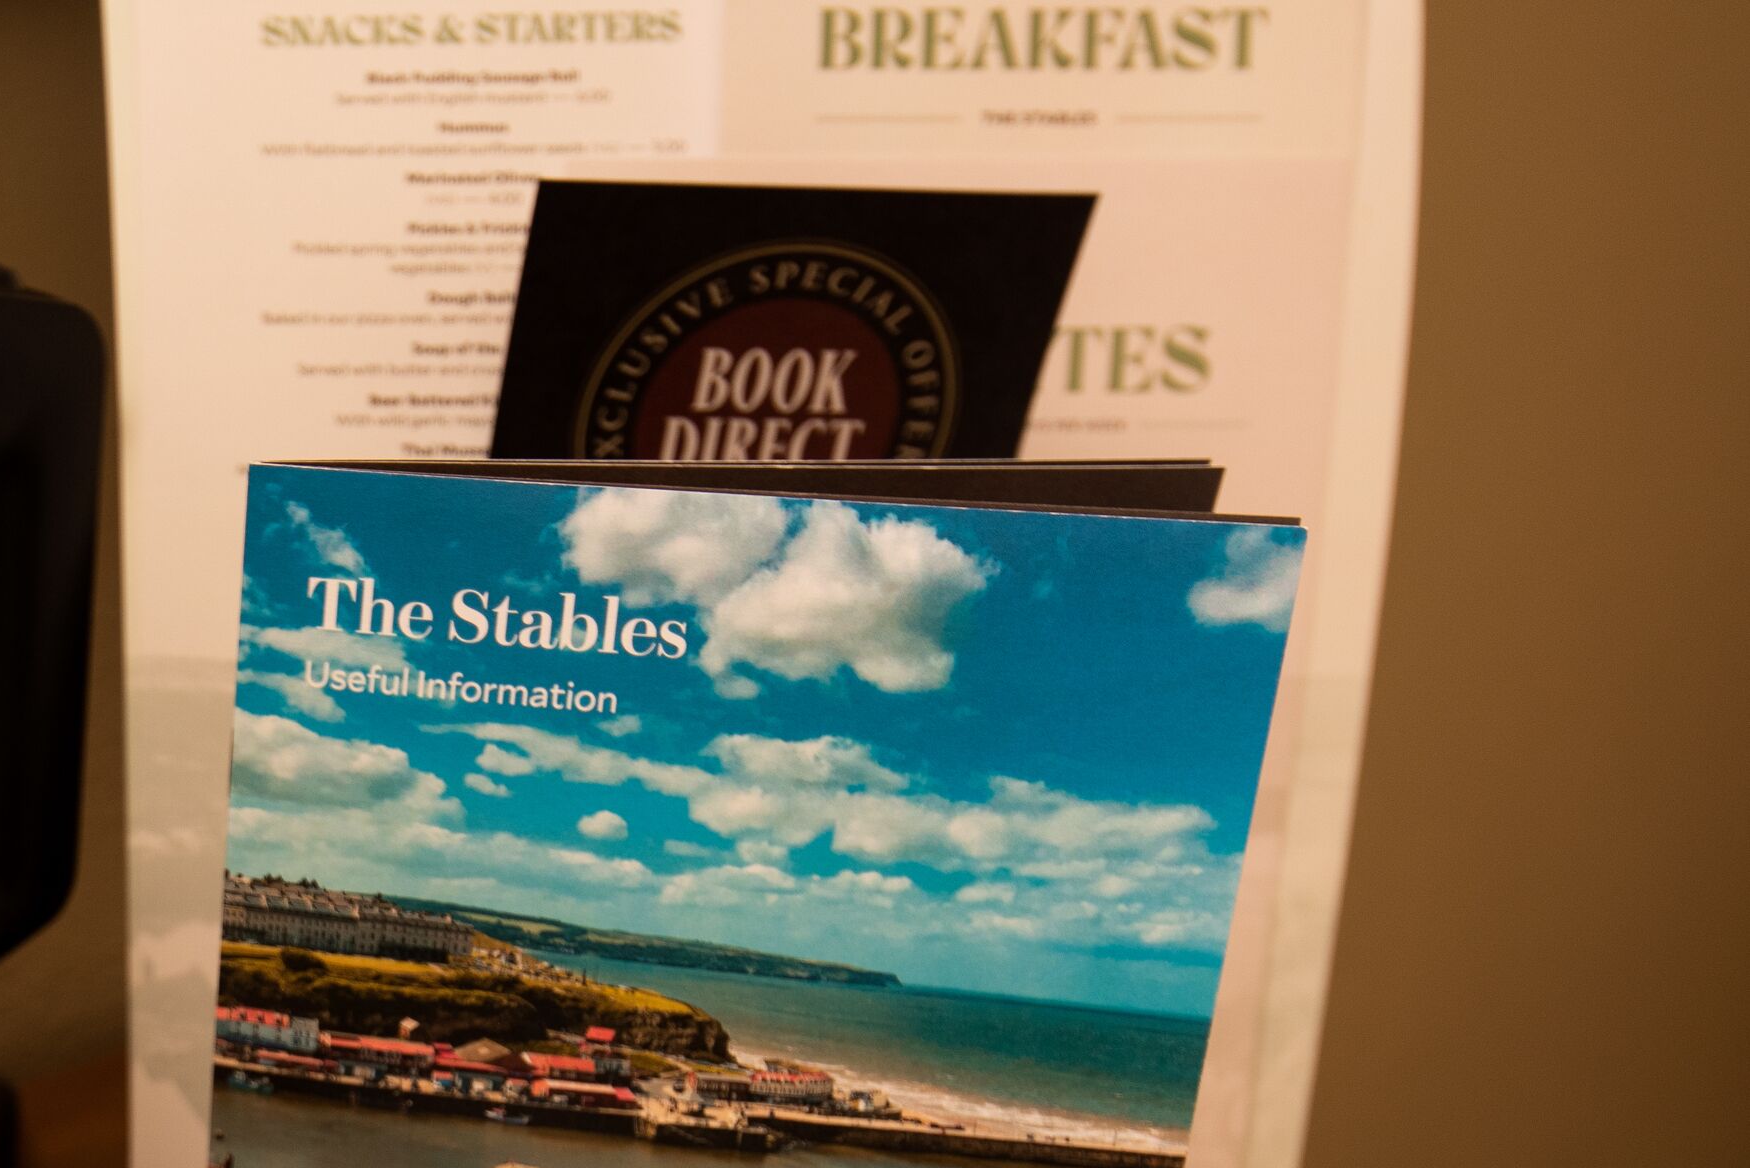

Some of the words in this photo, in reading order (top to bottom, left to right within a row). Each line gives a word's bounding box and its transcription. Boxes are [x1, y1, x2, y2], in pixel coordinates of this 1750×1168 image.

[259, 13, 424, 47] SNACKS
[434, 13, 464, 44] &
[473, 9, 683, 44] STARTERS
[818, 5, 1270, 71] BREAKFAST
[592, 275, 734, 459] XCLUSIVE
[749, 260, 914, 336] SPECIAL
[690, 345, 860, 415] BOOK
[1054, 322, 1211, 395] TES
[658, 414, 867, 461] DIRECT
[307, 576, 434, 640] The
[448, 588, 688, 660] Stables
[304, 658, 410, 699] Useful
[417, 668, 619, 715] Information
